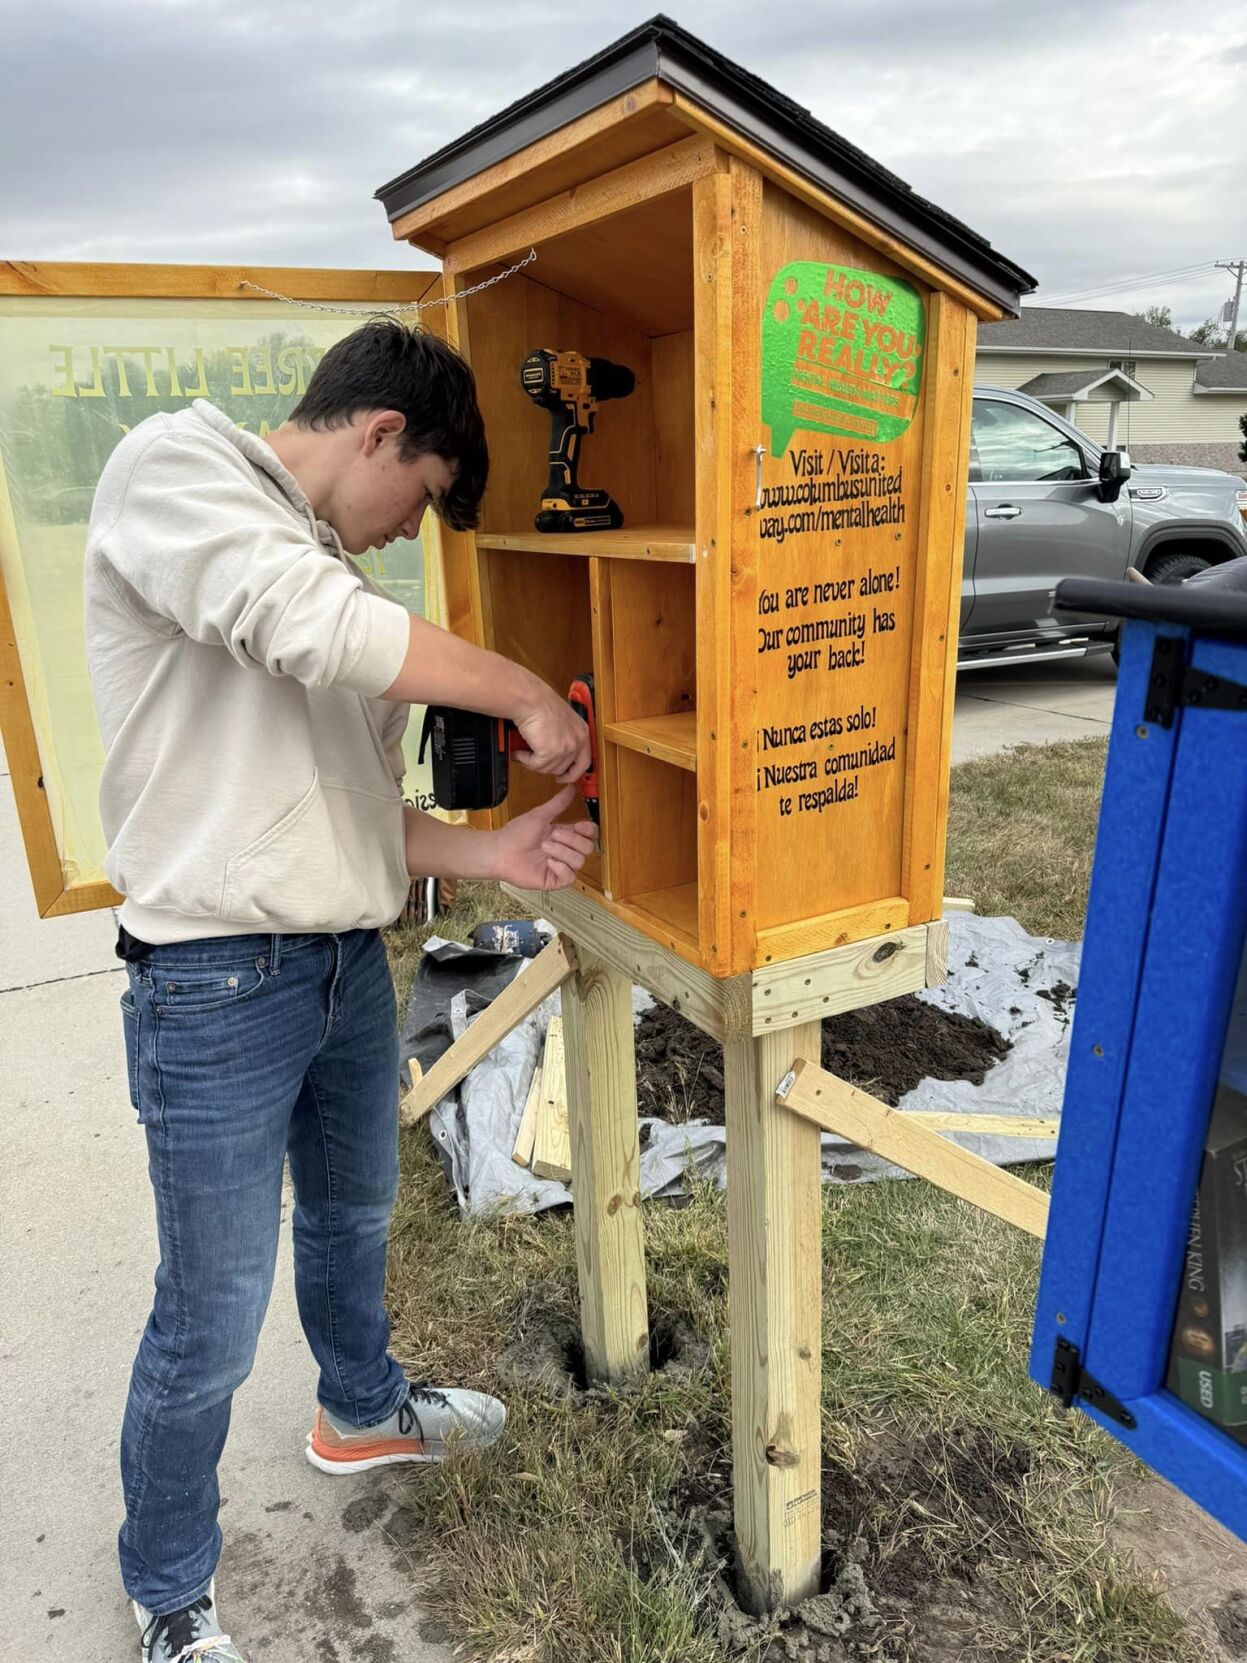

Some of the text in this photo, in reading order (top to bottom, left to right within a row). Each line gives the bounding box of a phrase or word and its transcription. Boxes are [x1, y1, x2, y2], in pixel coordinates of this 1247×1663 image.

[823, 268, 893, 318] HOW
[801, 299, 859, 342] ARE
[798, 329, 917, 389] REALLY?
[790, 448, 886, 477] Visit / Visita:
[785, 586, 809, 609] are
[813, 579, 856, 604] never
[859, 566, 900, 597] alone!
[786, 612, 866, 647] community
[873, 607, 896, 633] has
[787, 640, 865, 679] your back!
[810, 716, 843, 740] estas
[846, 705, 877, 733] solo!
[824, 736, 896, 776] comunidad
[779, 775, 858, 816] te respalda!
[1186, 1250, 1205, 1293] KING
[1199, 1370, 1213, 1408] USED
